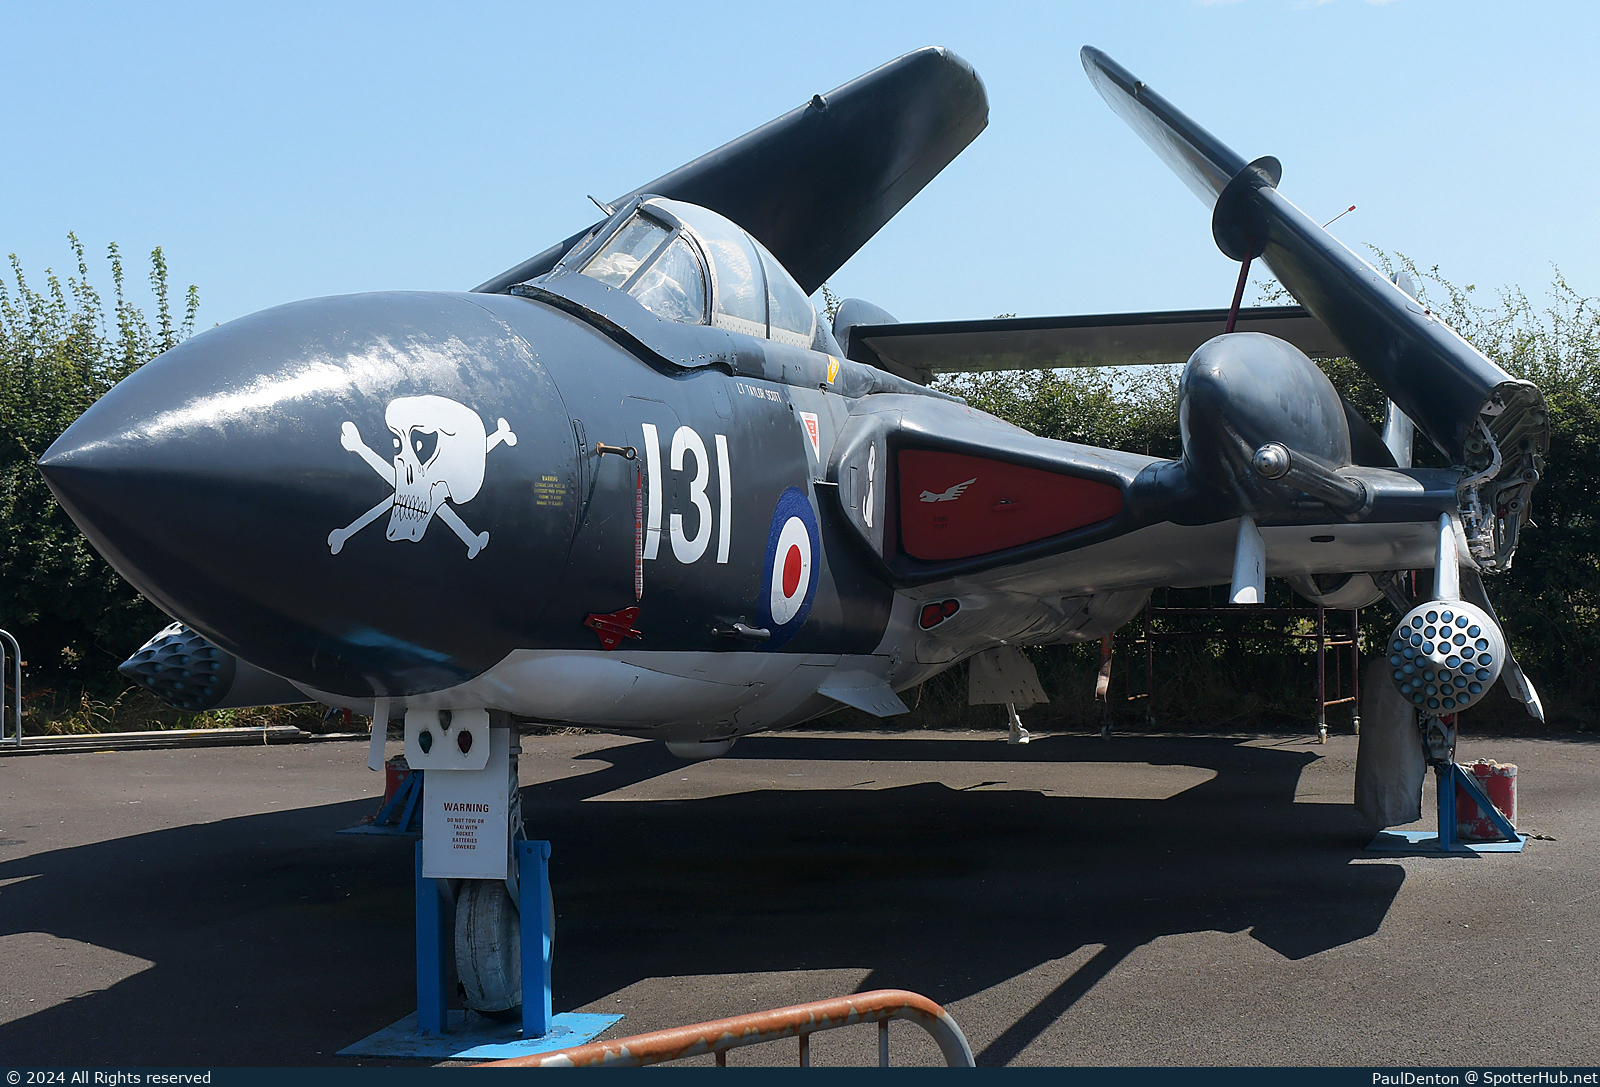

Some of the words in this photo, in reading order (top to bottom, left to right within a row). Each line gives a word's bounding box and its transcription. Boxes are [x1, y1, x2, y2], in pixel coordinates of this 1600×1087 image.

[735, 382, 745, 394] LT
[745, 384, 766, 400] TAYLOR
[765, 389, 782, 403] SCOTT
[642, 422, 732, 564] 131
[634, 564, 643, 594] FLIGHT
[443, 802, 489, 813] WARNING
